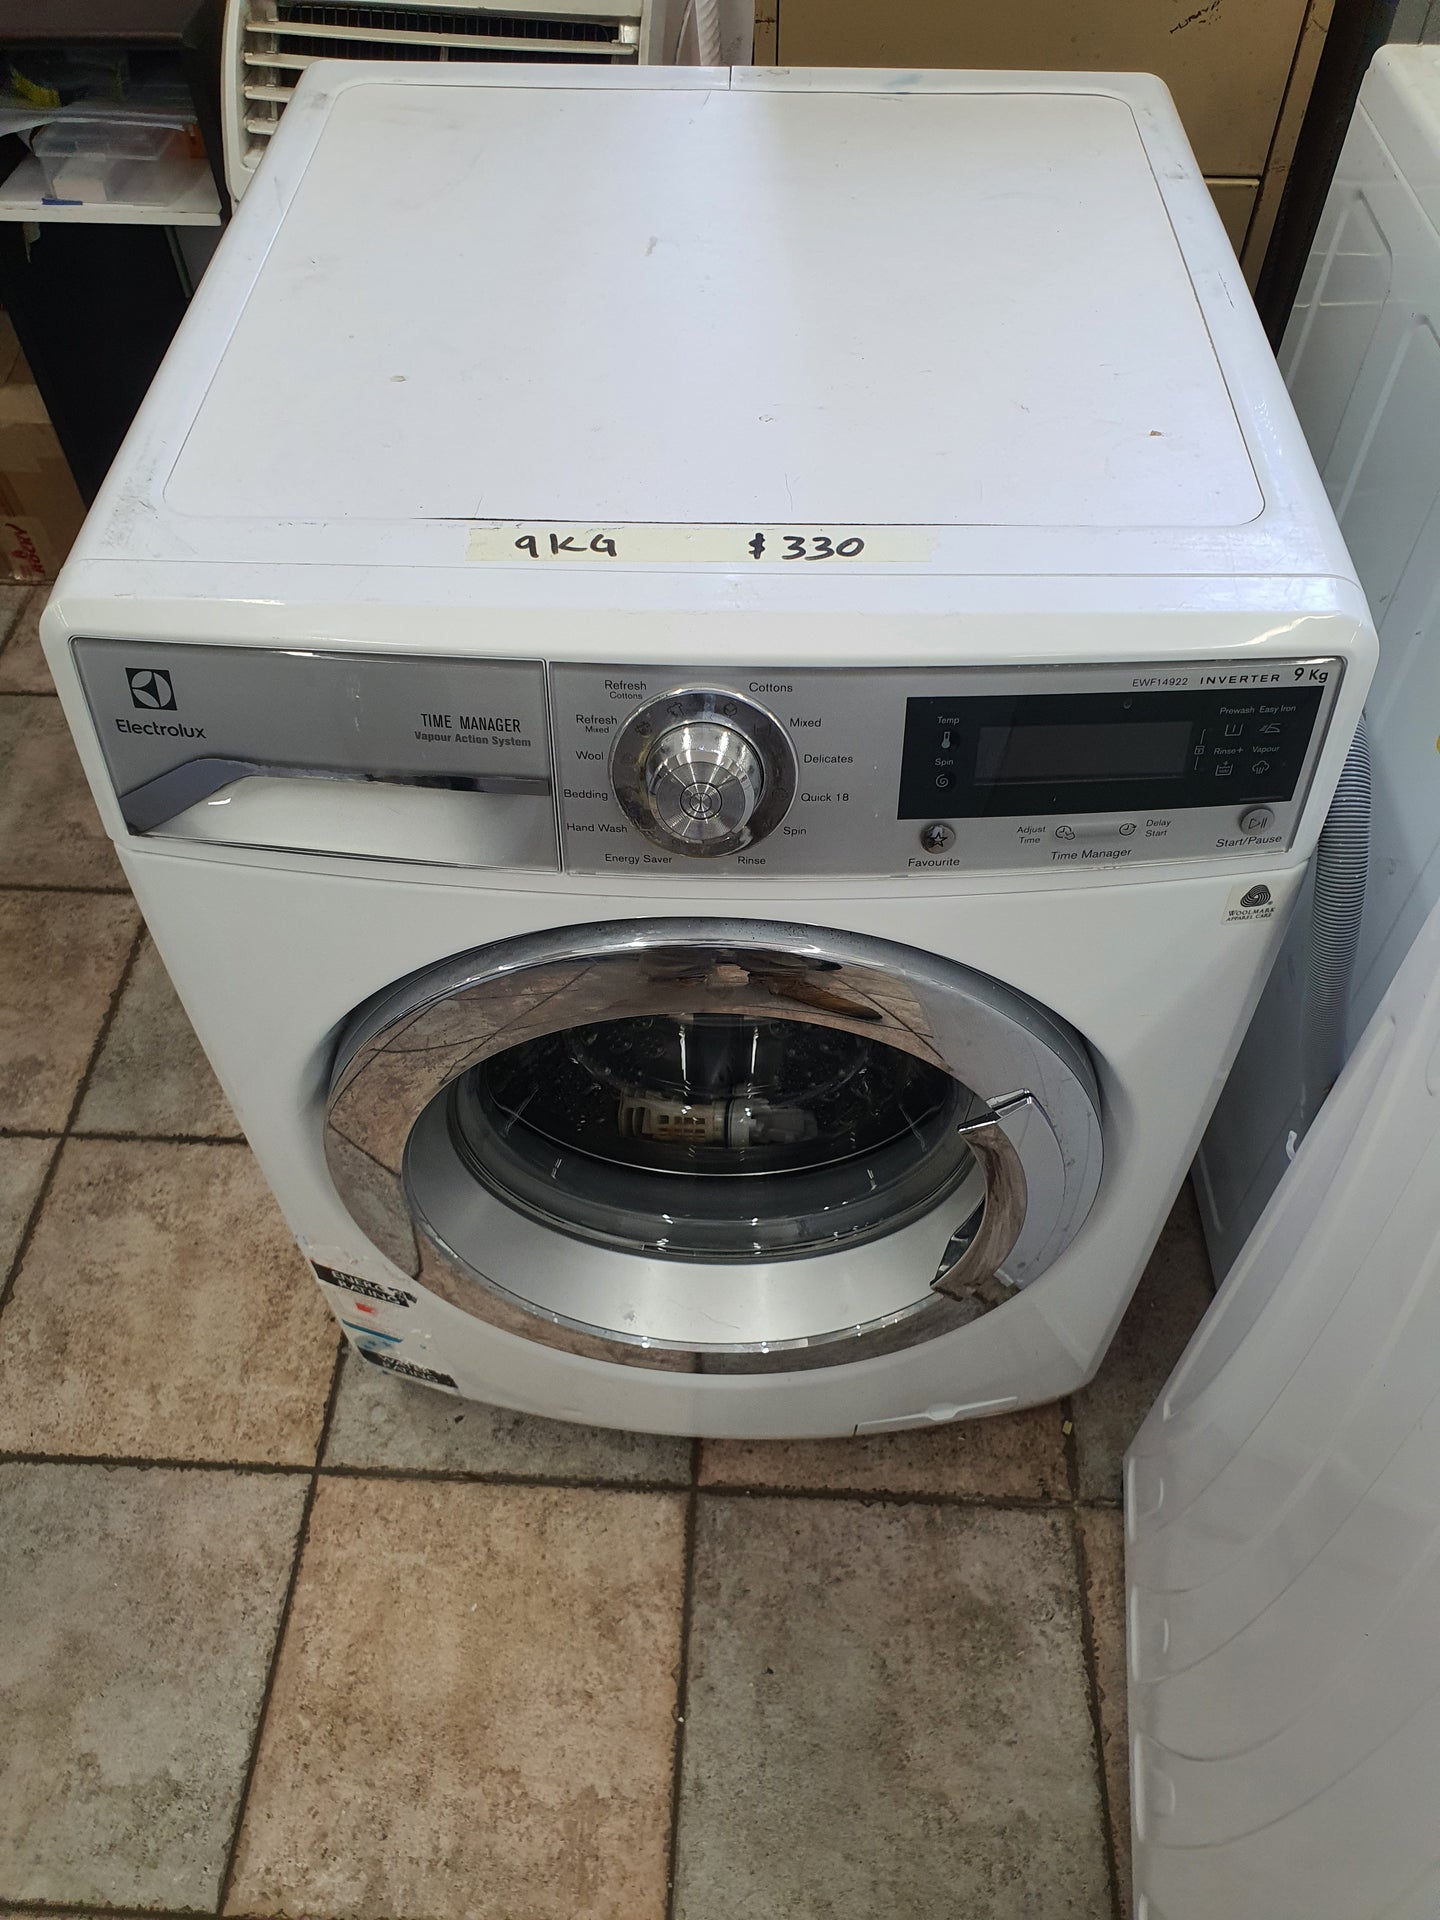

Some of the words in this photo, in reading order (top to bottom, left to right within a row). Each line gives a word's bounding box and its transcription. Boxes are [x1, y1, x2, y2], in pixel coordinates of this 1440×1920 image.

[604, 679, 647, 691] Refresh
[1132, 677, 1188, 688] EWF14922
[1200, 674, 1280, 685] INVERTER
[749, 681, 793, 693] Cottons
[609, 691, 643, 700] Cottons
[1220, 706, 1255, 715] Prewash
[1259, 705, 1280, 715] Easy
[1280, 704, 1297, 712] Iron
[420, 713, 453, 729] TIME
[459, 715, 522, 733] MANAGER
[575, 714, 618, 725] Refresh
[789, 717, 822, 728] Mixed
[937, 716, 960, 726] Temp
[115, 718, 207, 739] Electrolux
[585, 725, 610, 734] Mixed
[414, 731, 452, 742] Vapour
[454, 733, 489, 745] Action
[491, 735, 532, 748] System
[1252, 745, 1281, 754] Vapour
[575, 750, 604, 761] Wool
[803, 753, 854, 764] Delicates
[934, 757, 954, 767] Spin
[563, 788, 609, 802] Bedding
[800, 792, 832, 802] Quick
[836, 793, 850, 802] 18
[566, 822, 595, 832] Hand
[599, 823, 628, 833] Wash
[1146, 818, 1172, 828] Delay
[783, 826, 807, 837] Spin
[1016, 825, 1046, 835] Adjust
[1145, 828, 1168, 838] Start
[1019, 836, 1041, 845] Time
[1215, 834, 1283, 849] Start/Pause
[604, 853, 640, 865] Energy
[643, 854, 673, 864] Saver
[1051, 850, 1078, 861] Time
[1081, 847, 1132, 860] Manager
[737, 855, 766, 865] Rinse
[908, 857, 961, 868] Favourite
[1228, 907, 1276, 917] WOOLMARK
